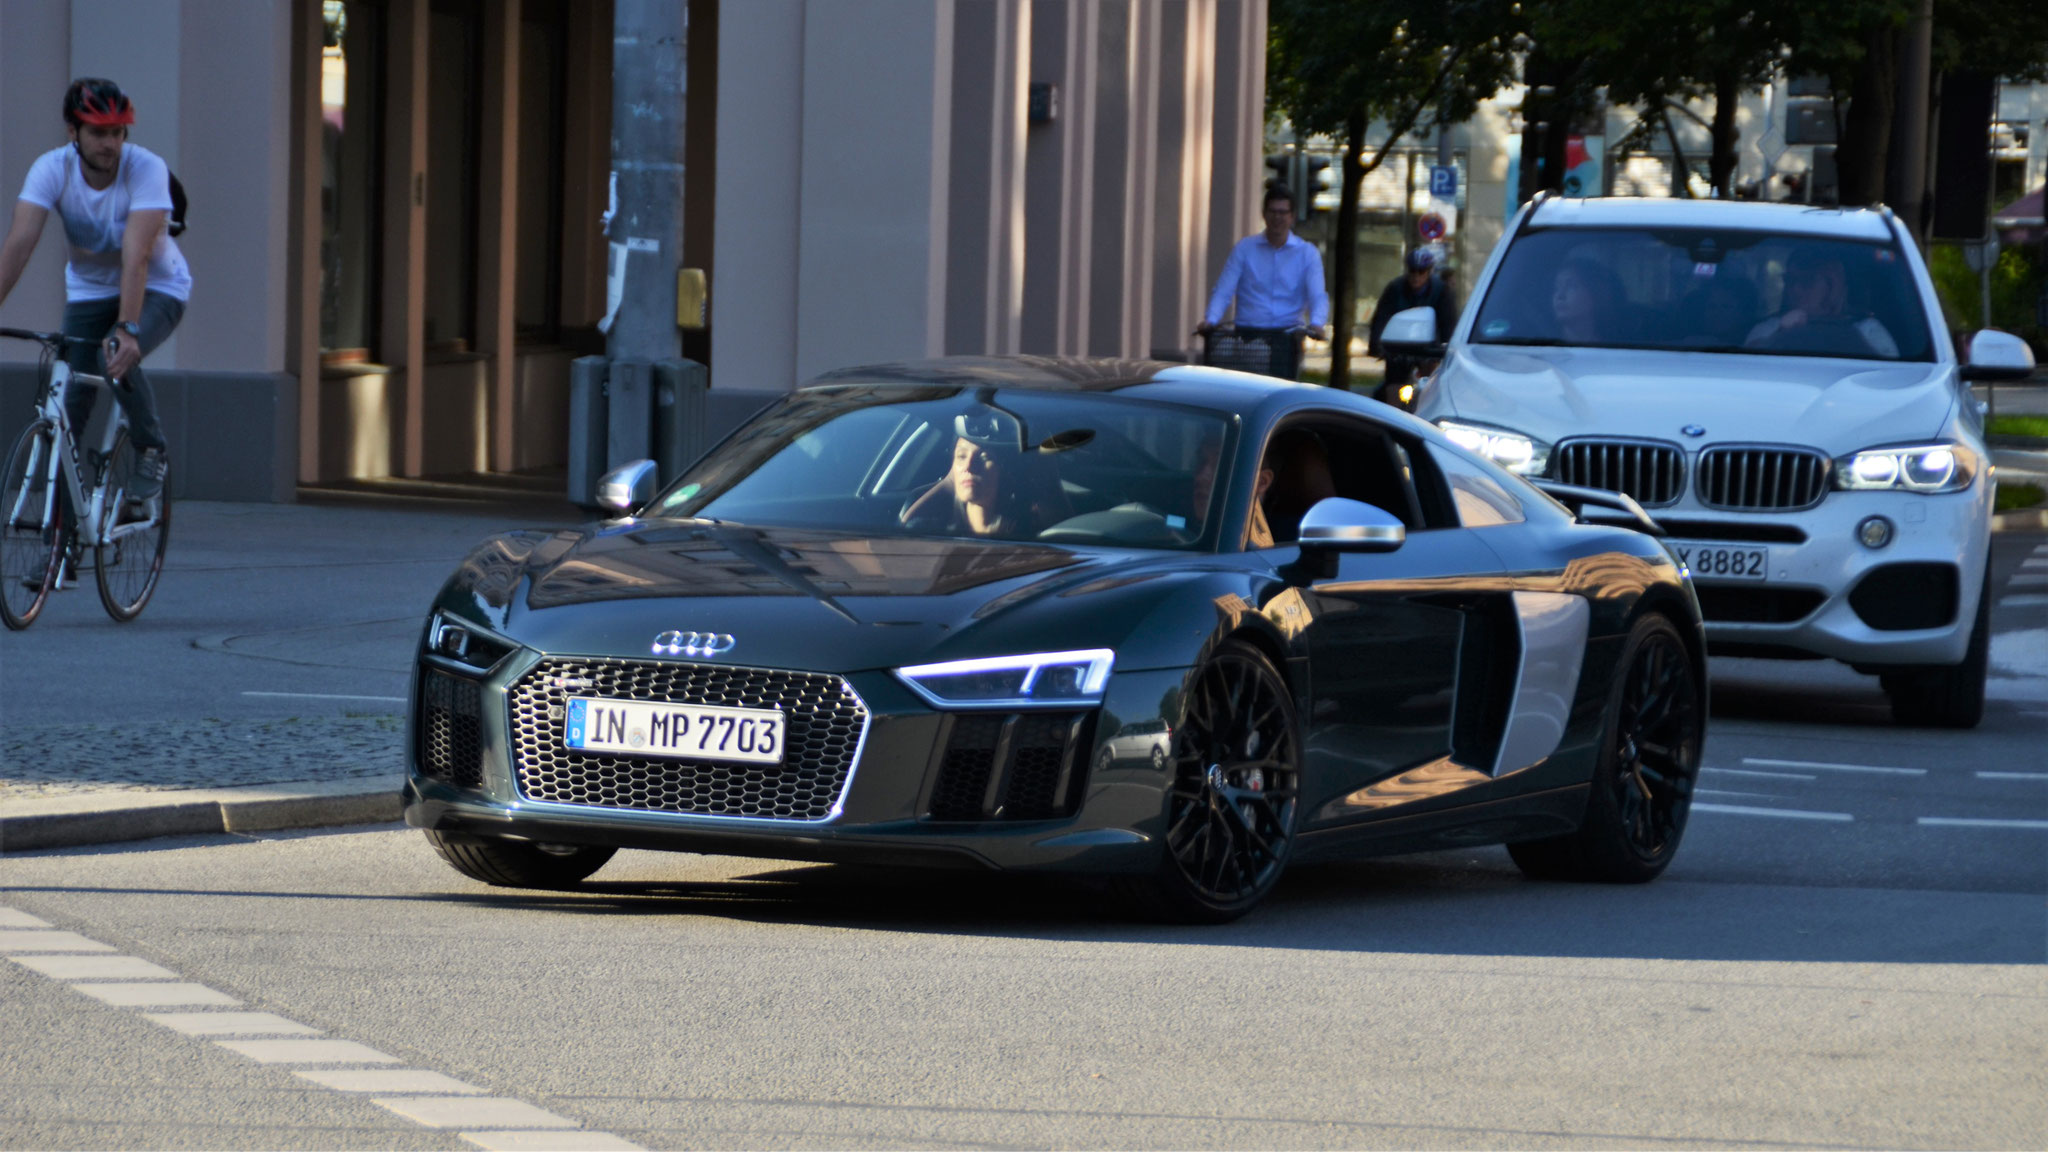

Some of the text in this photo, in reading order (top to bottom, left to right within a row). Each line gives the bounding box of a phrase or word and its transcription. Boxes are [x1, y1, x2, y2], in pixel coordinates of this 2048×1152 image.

[1433, 169, 1449, 192] P
[1697, 549, 1763, 576] 8882
[571, 727, 581, 740] D
[590, 707, 778, 754] IN MP 7703
